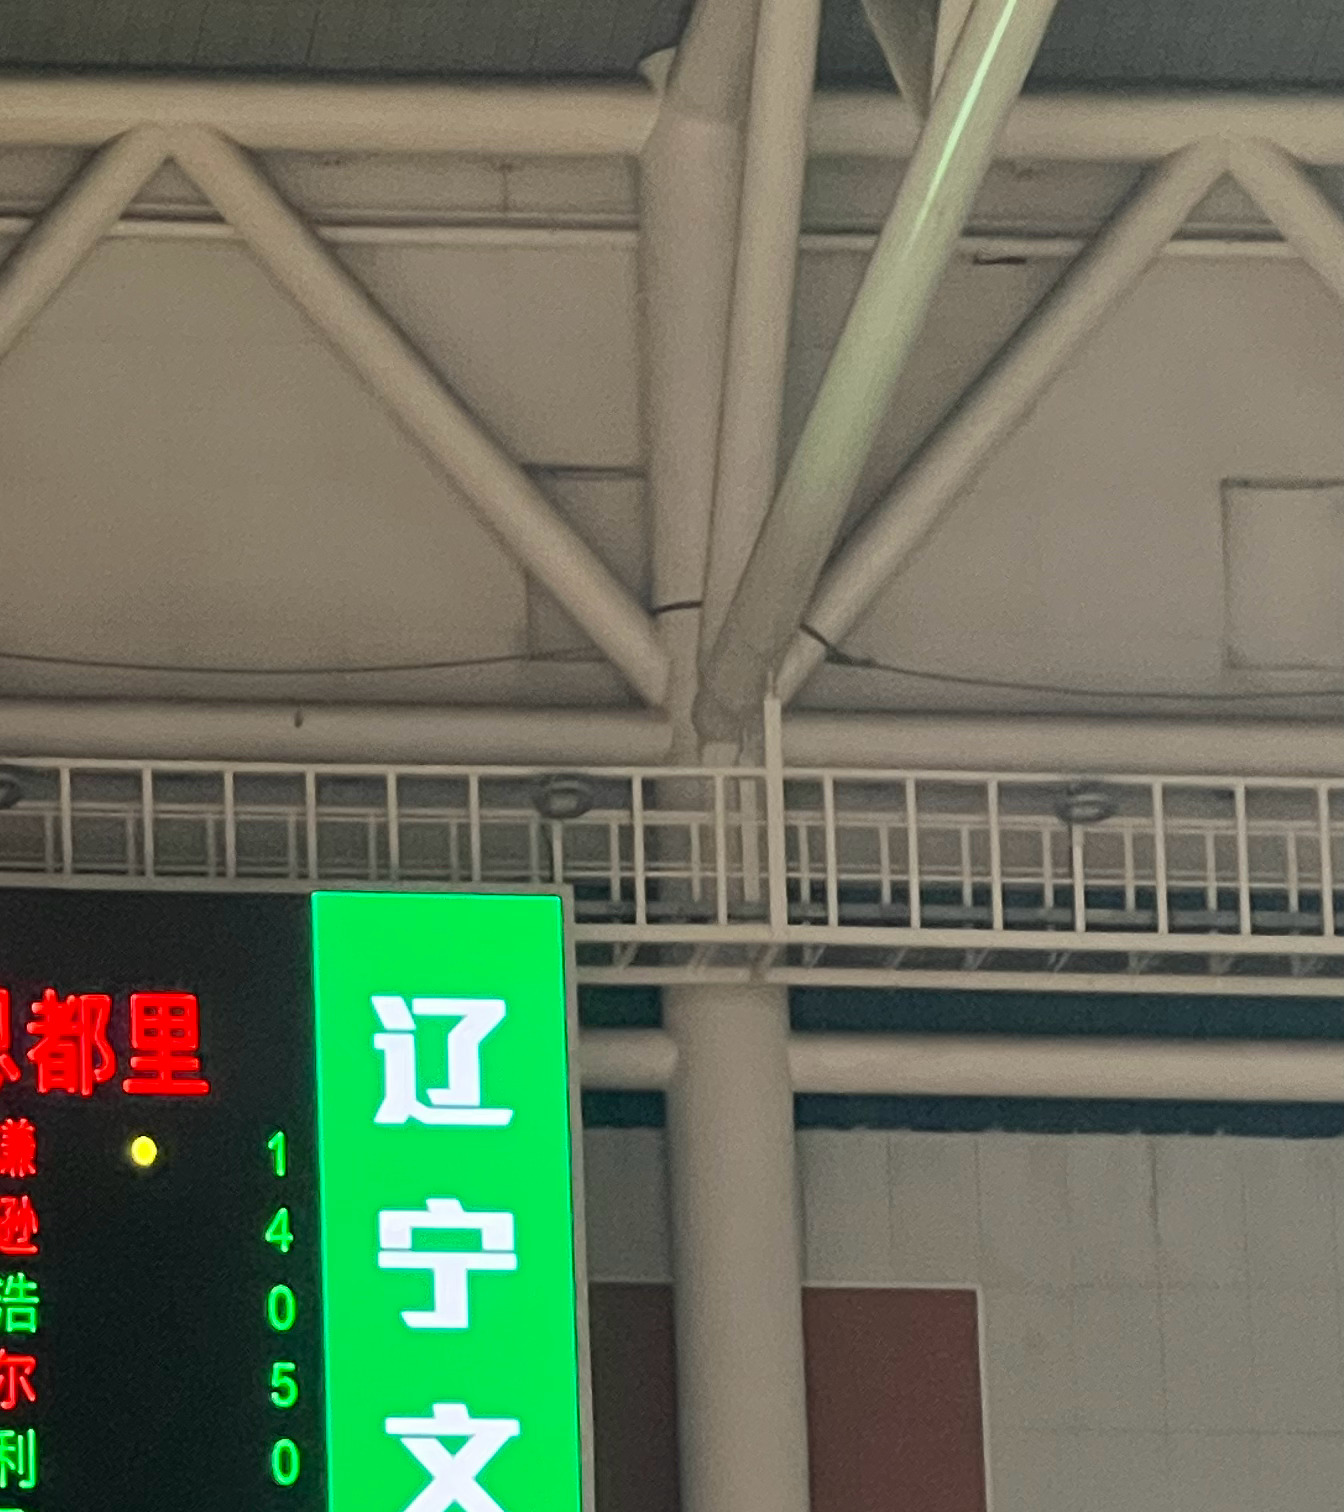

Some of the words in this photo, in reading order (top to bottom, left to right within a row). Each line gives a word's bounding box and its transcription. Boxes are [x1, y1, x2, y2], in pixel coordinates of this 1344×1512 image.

[267, 1131, 285, 1176] 1
[265, 1208, 293, 1252] 4
[268, 1284, 296, 1330] 0
[271, 1362, 298, 1408] 5
[271, 1439, 300, 1485] 0
